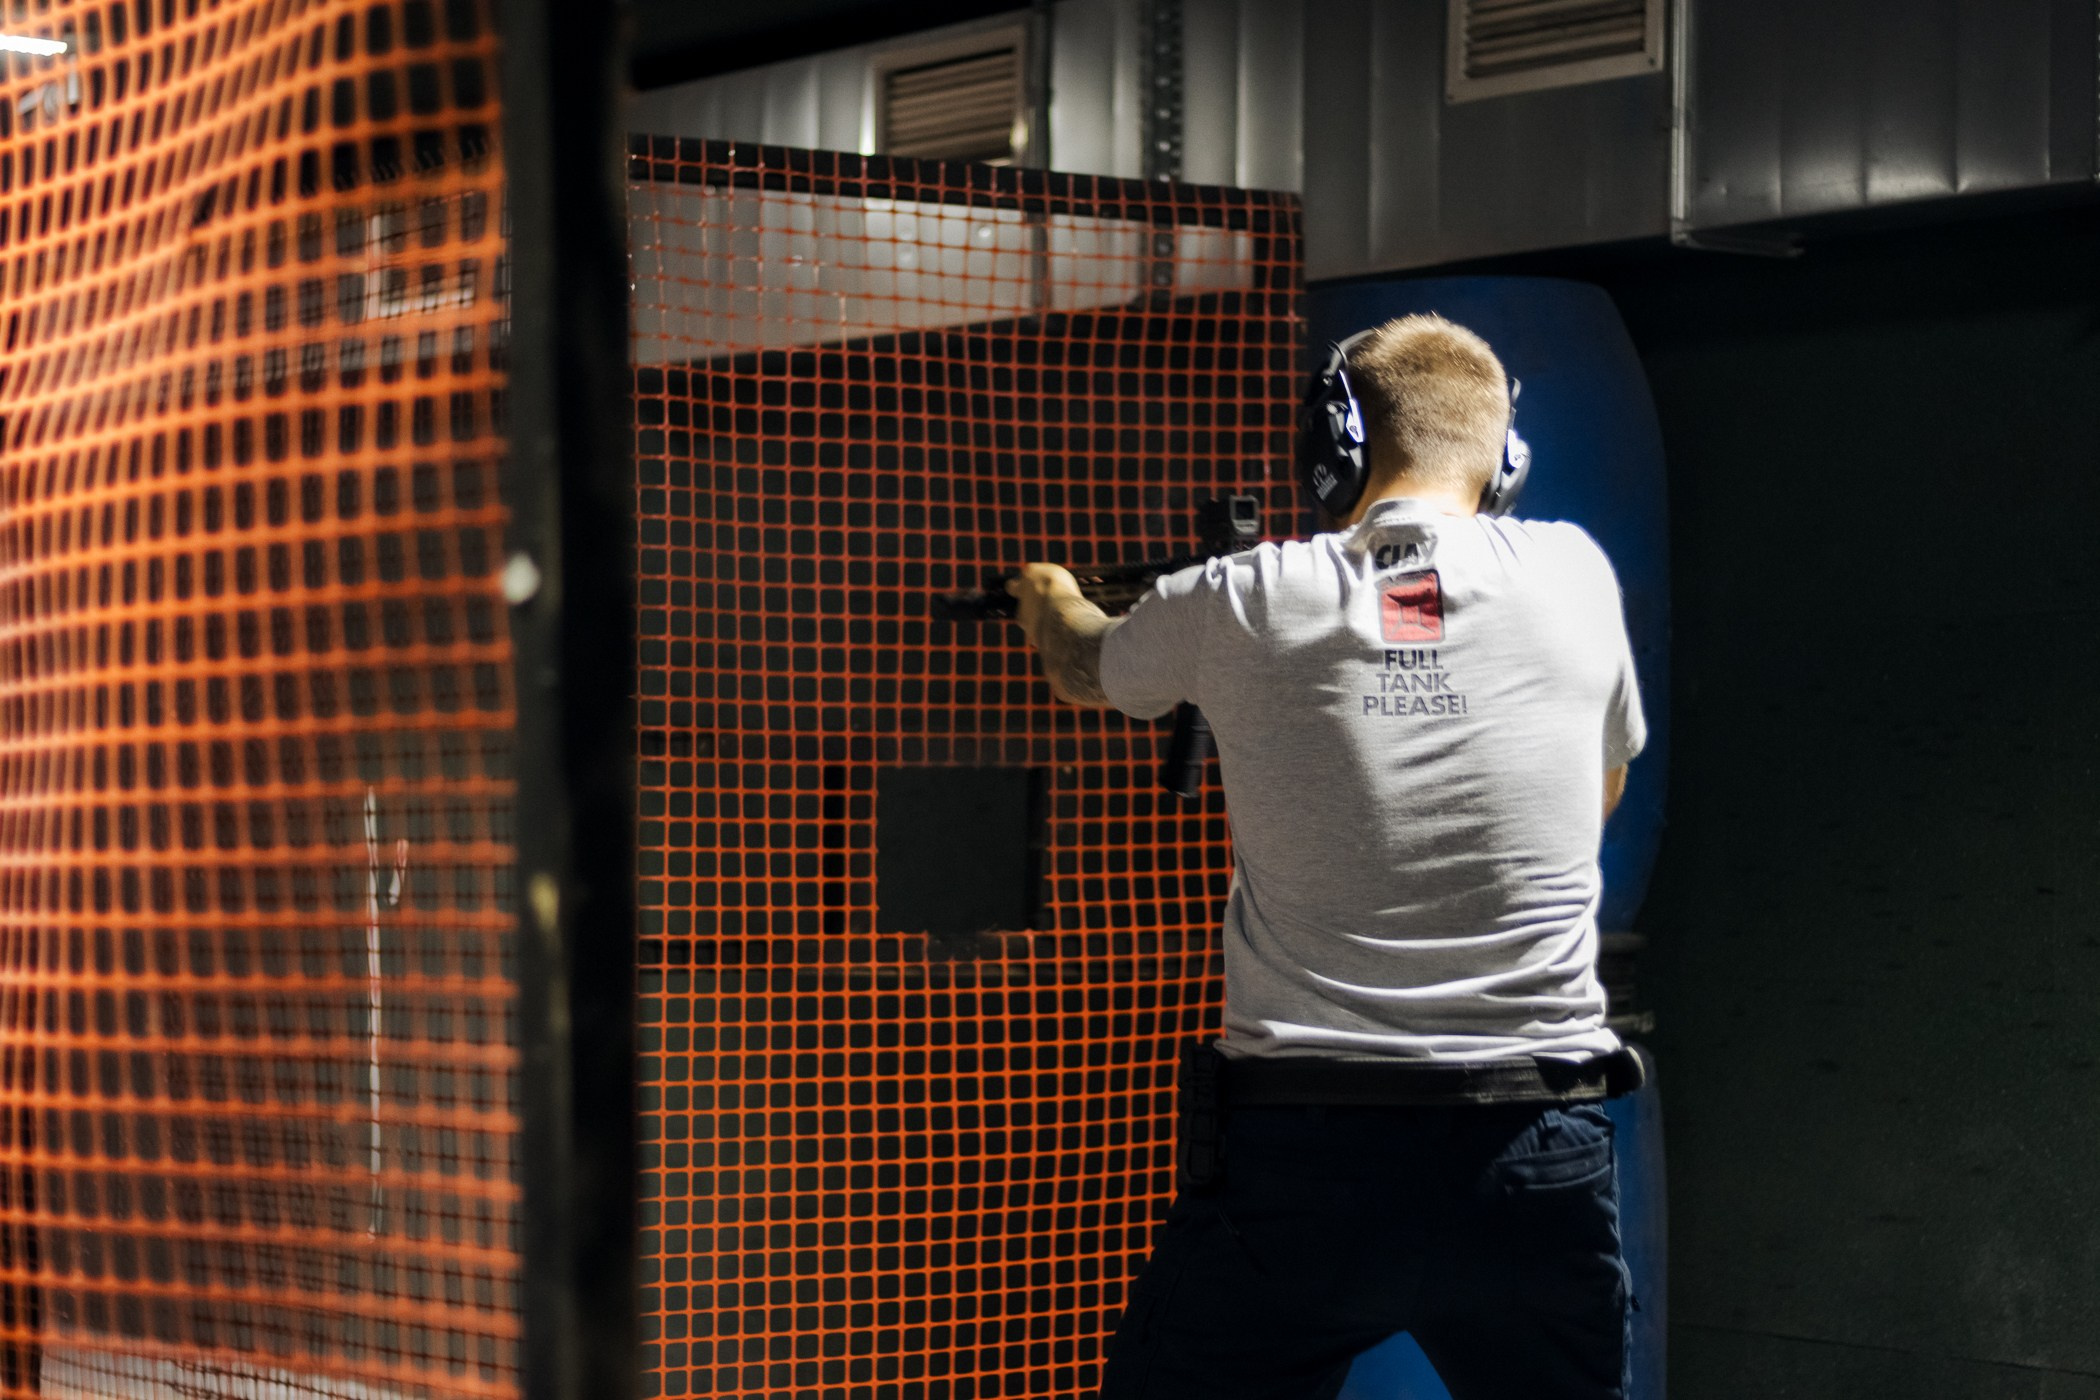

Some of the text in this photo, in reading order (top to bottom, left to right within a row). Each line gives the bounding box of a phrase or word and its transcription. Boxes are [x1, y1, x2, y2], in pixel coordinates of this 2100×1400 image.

[1384, 649, 1443, 670] FULL
[1376, 672, 1453, 693] TANK
[1362, 694, 1467, 716] PLEASE!
